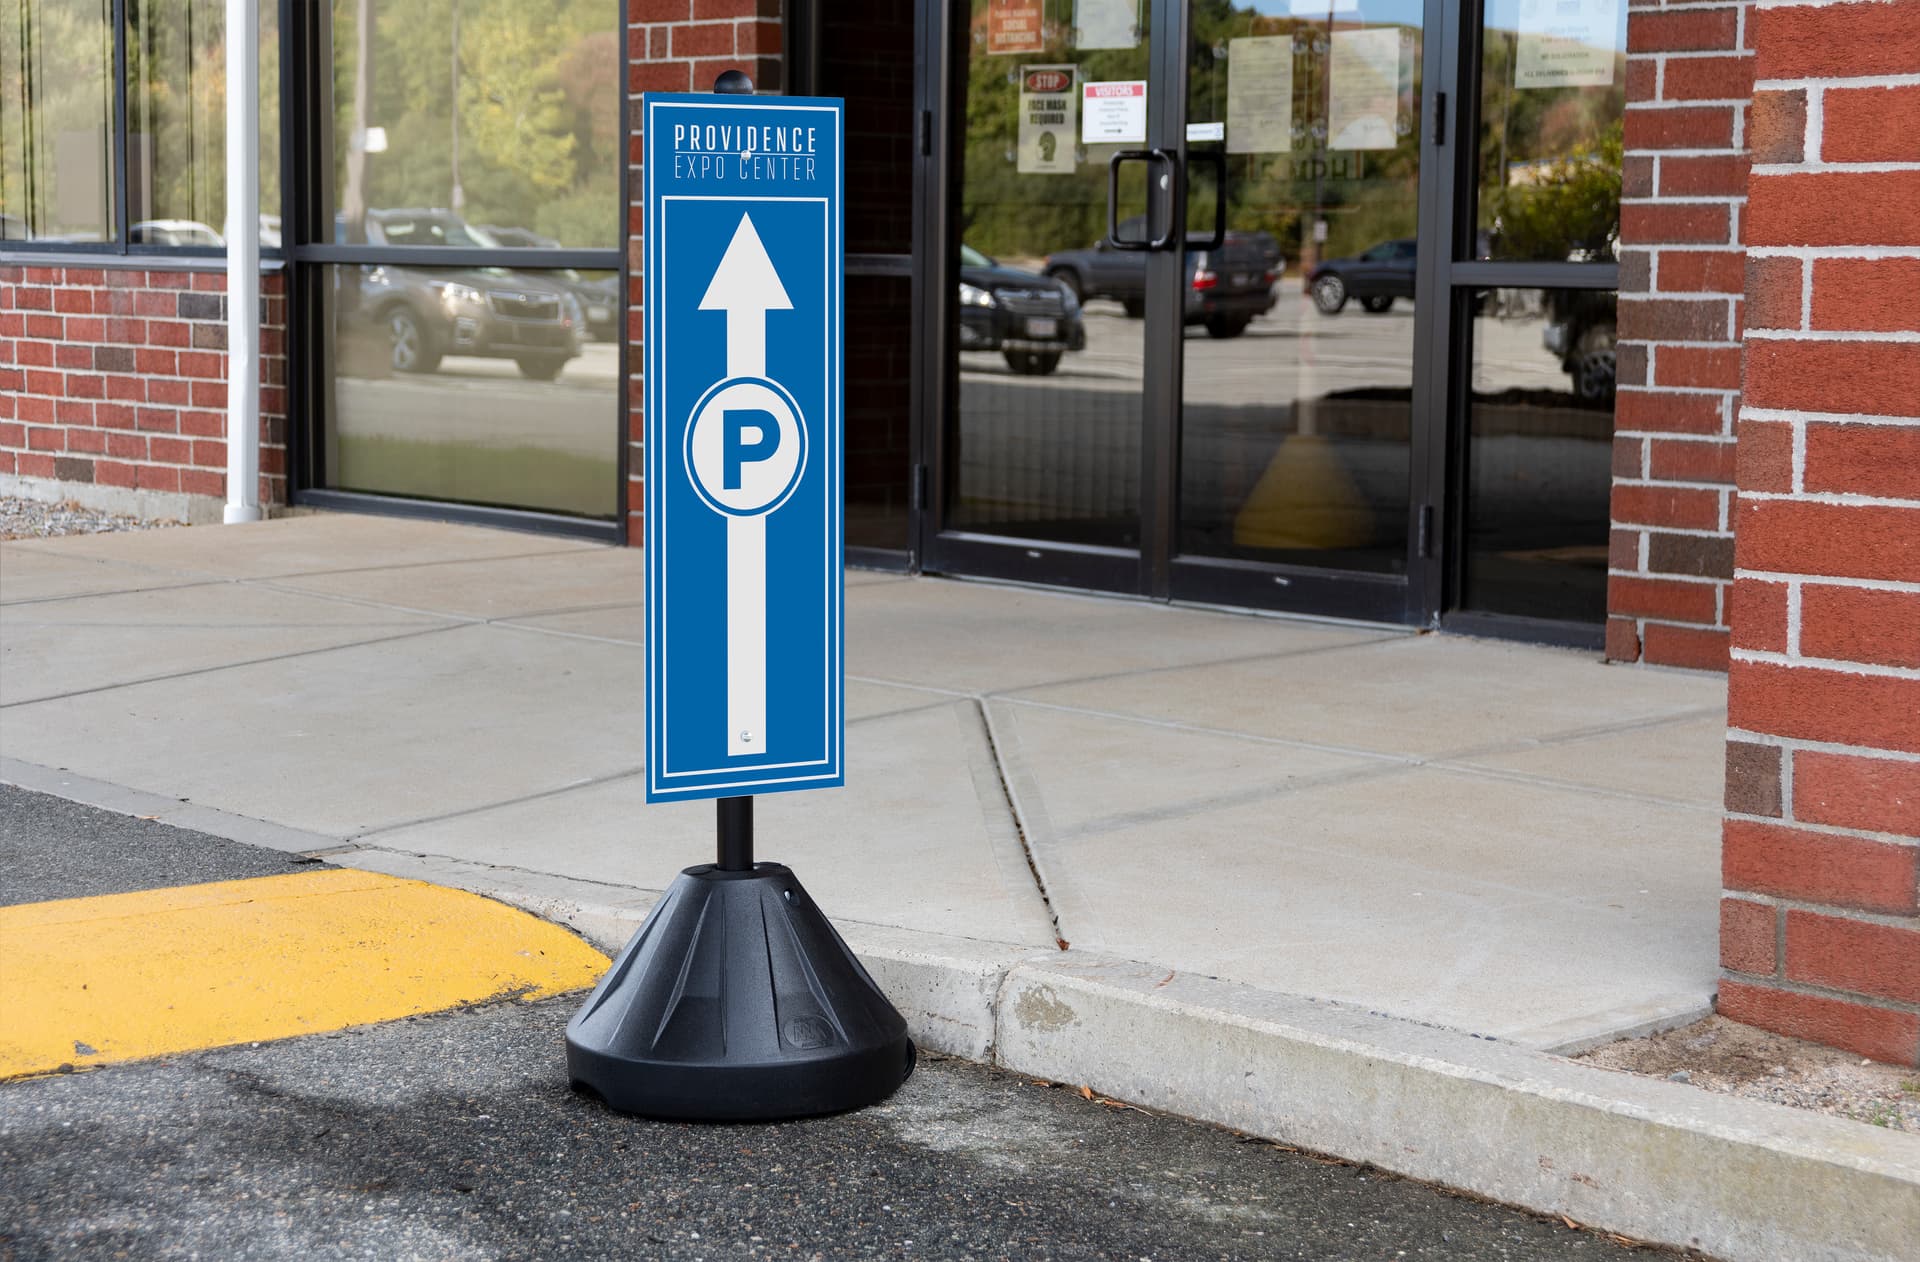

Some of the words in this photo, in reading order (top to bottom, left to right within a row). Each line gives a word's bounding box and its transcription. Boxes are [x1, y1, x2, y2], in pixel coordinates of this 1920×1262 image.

[1036, 74, 1059, 88] STOP
[1095, 85, 1134, 98] VISITORS
[1028, 100, 1044, 111] FACE
[1046, 99, 1067, 111] MASK
[1030, 113, 1064, 125] REQUIRED
[674, 124, 816, 153] PROVIDENCE
[674, 155, 725, 180] EXPO
[739, 156, 816, 181] CENTER
[723, 409, 781, 490] P
